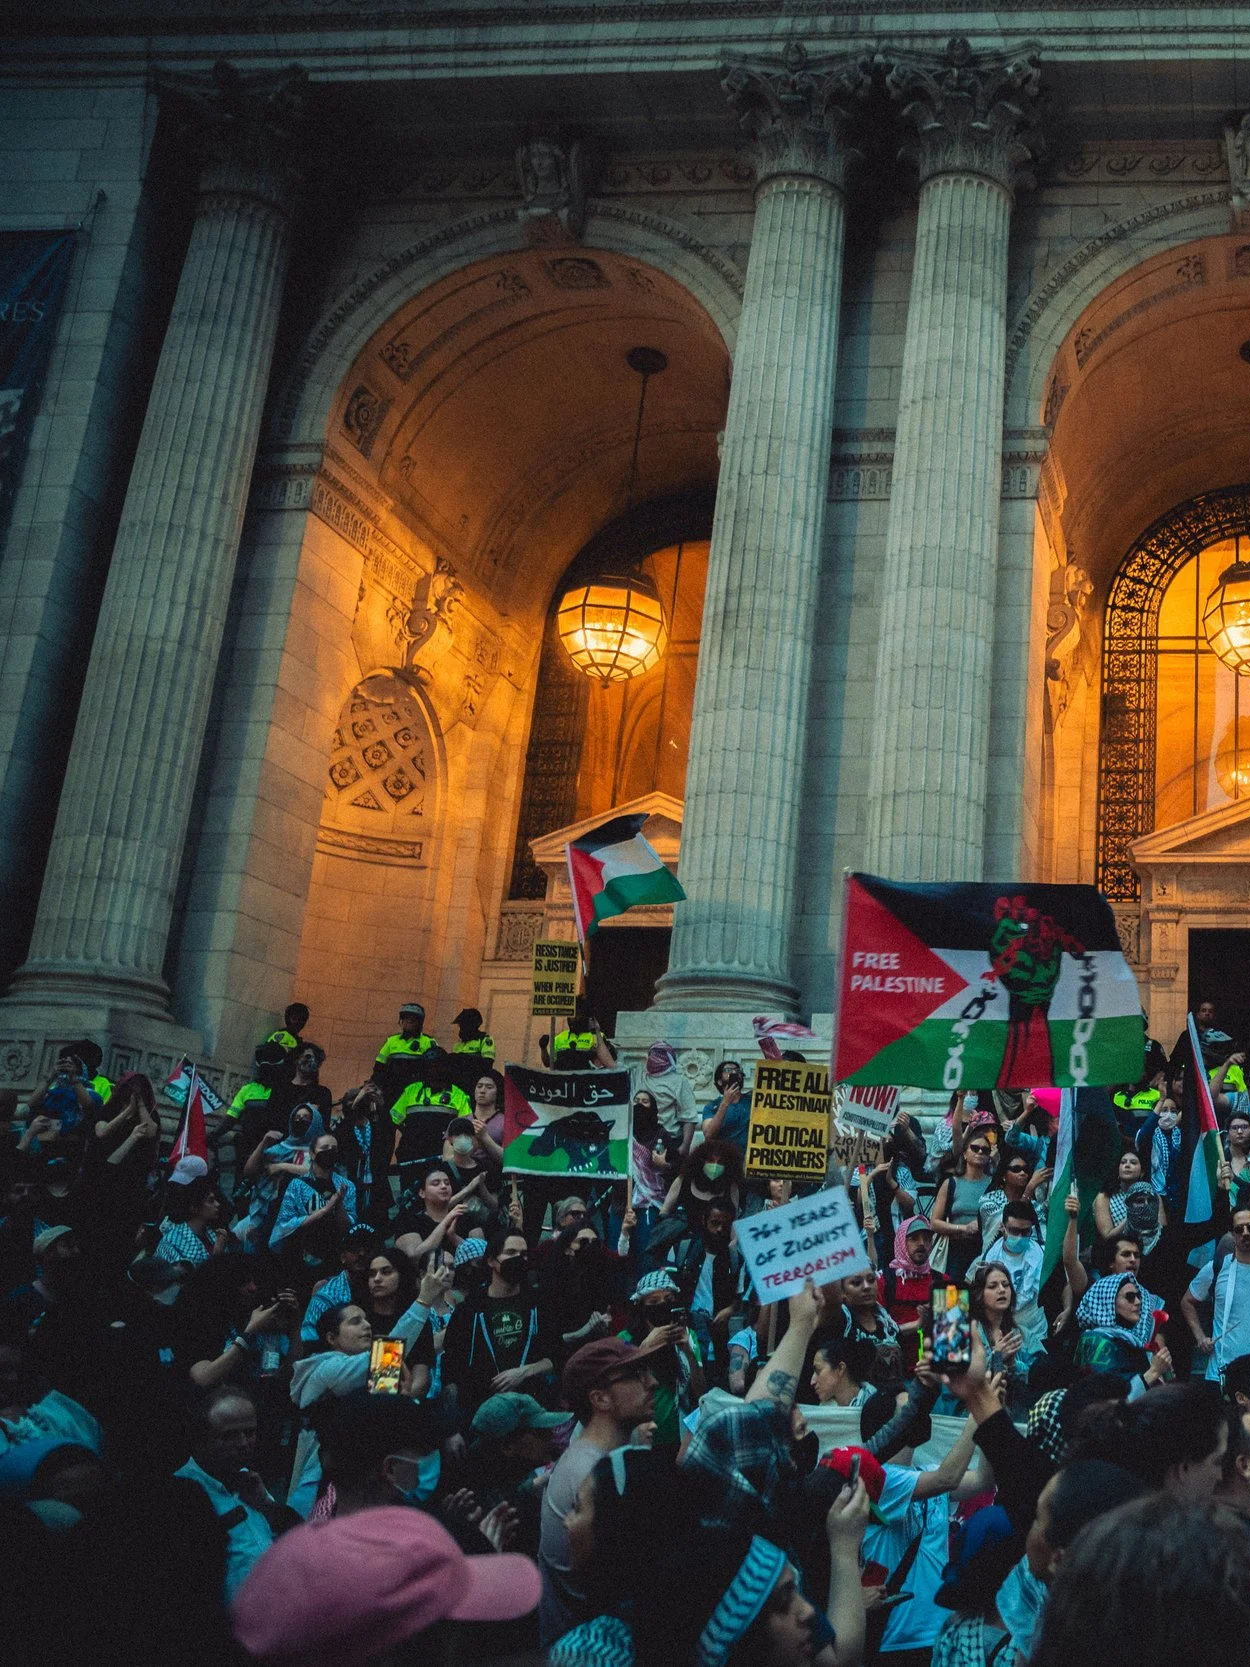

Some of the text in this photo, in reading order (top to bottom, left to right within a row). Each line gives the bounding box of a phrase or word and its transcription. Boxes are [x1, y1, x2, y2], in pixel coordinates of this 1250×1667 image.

[536, 944, 578, 959] RESISTANCE
[852, 951, 900, 969] FREE
[535, 959, 577, 973] IS JUSTIFIED
[534, 982, 553, 993] WHEN
[850, 974, 945, 993] PALESTINE
[534, 995, 546, 1005] ARE
[757, 1067, 833, 1095] FREE ALL
[583, 1084, 615, 1105] حق
[755, 1093, 831, 1114] PALESTINIAN
[849, 1086, 898, 1115] NOW!
[751, 1124, 826, 1149] POLITICAL
[749, 1148, 825, 1169] PRISONERS
[788, 1201, 838, 1229] YEARS
[755, 1222, 852, 1266] OF ZIONIST
[762, 1247, 856, 1288] TERRORISM
